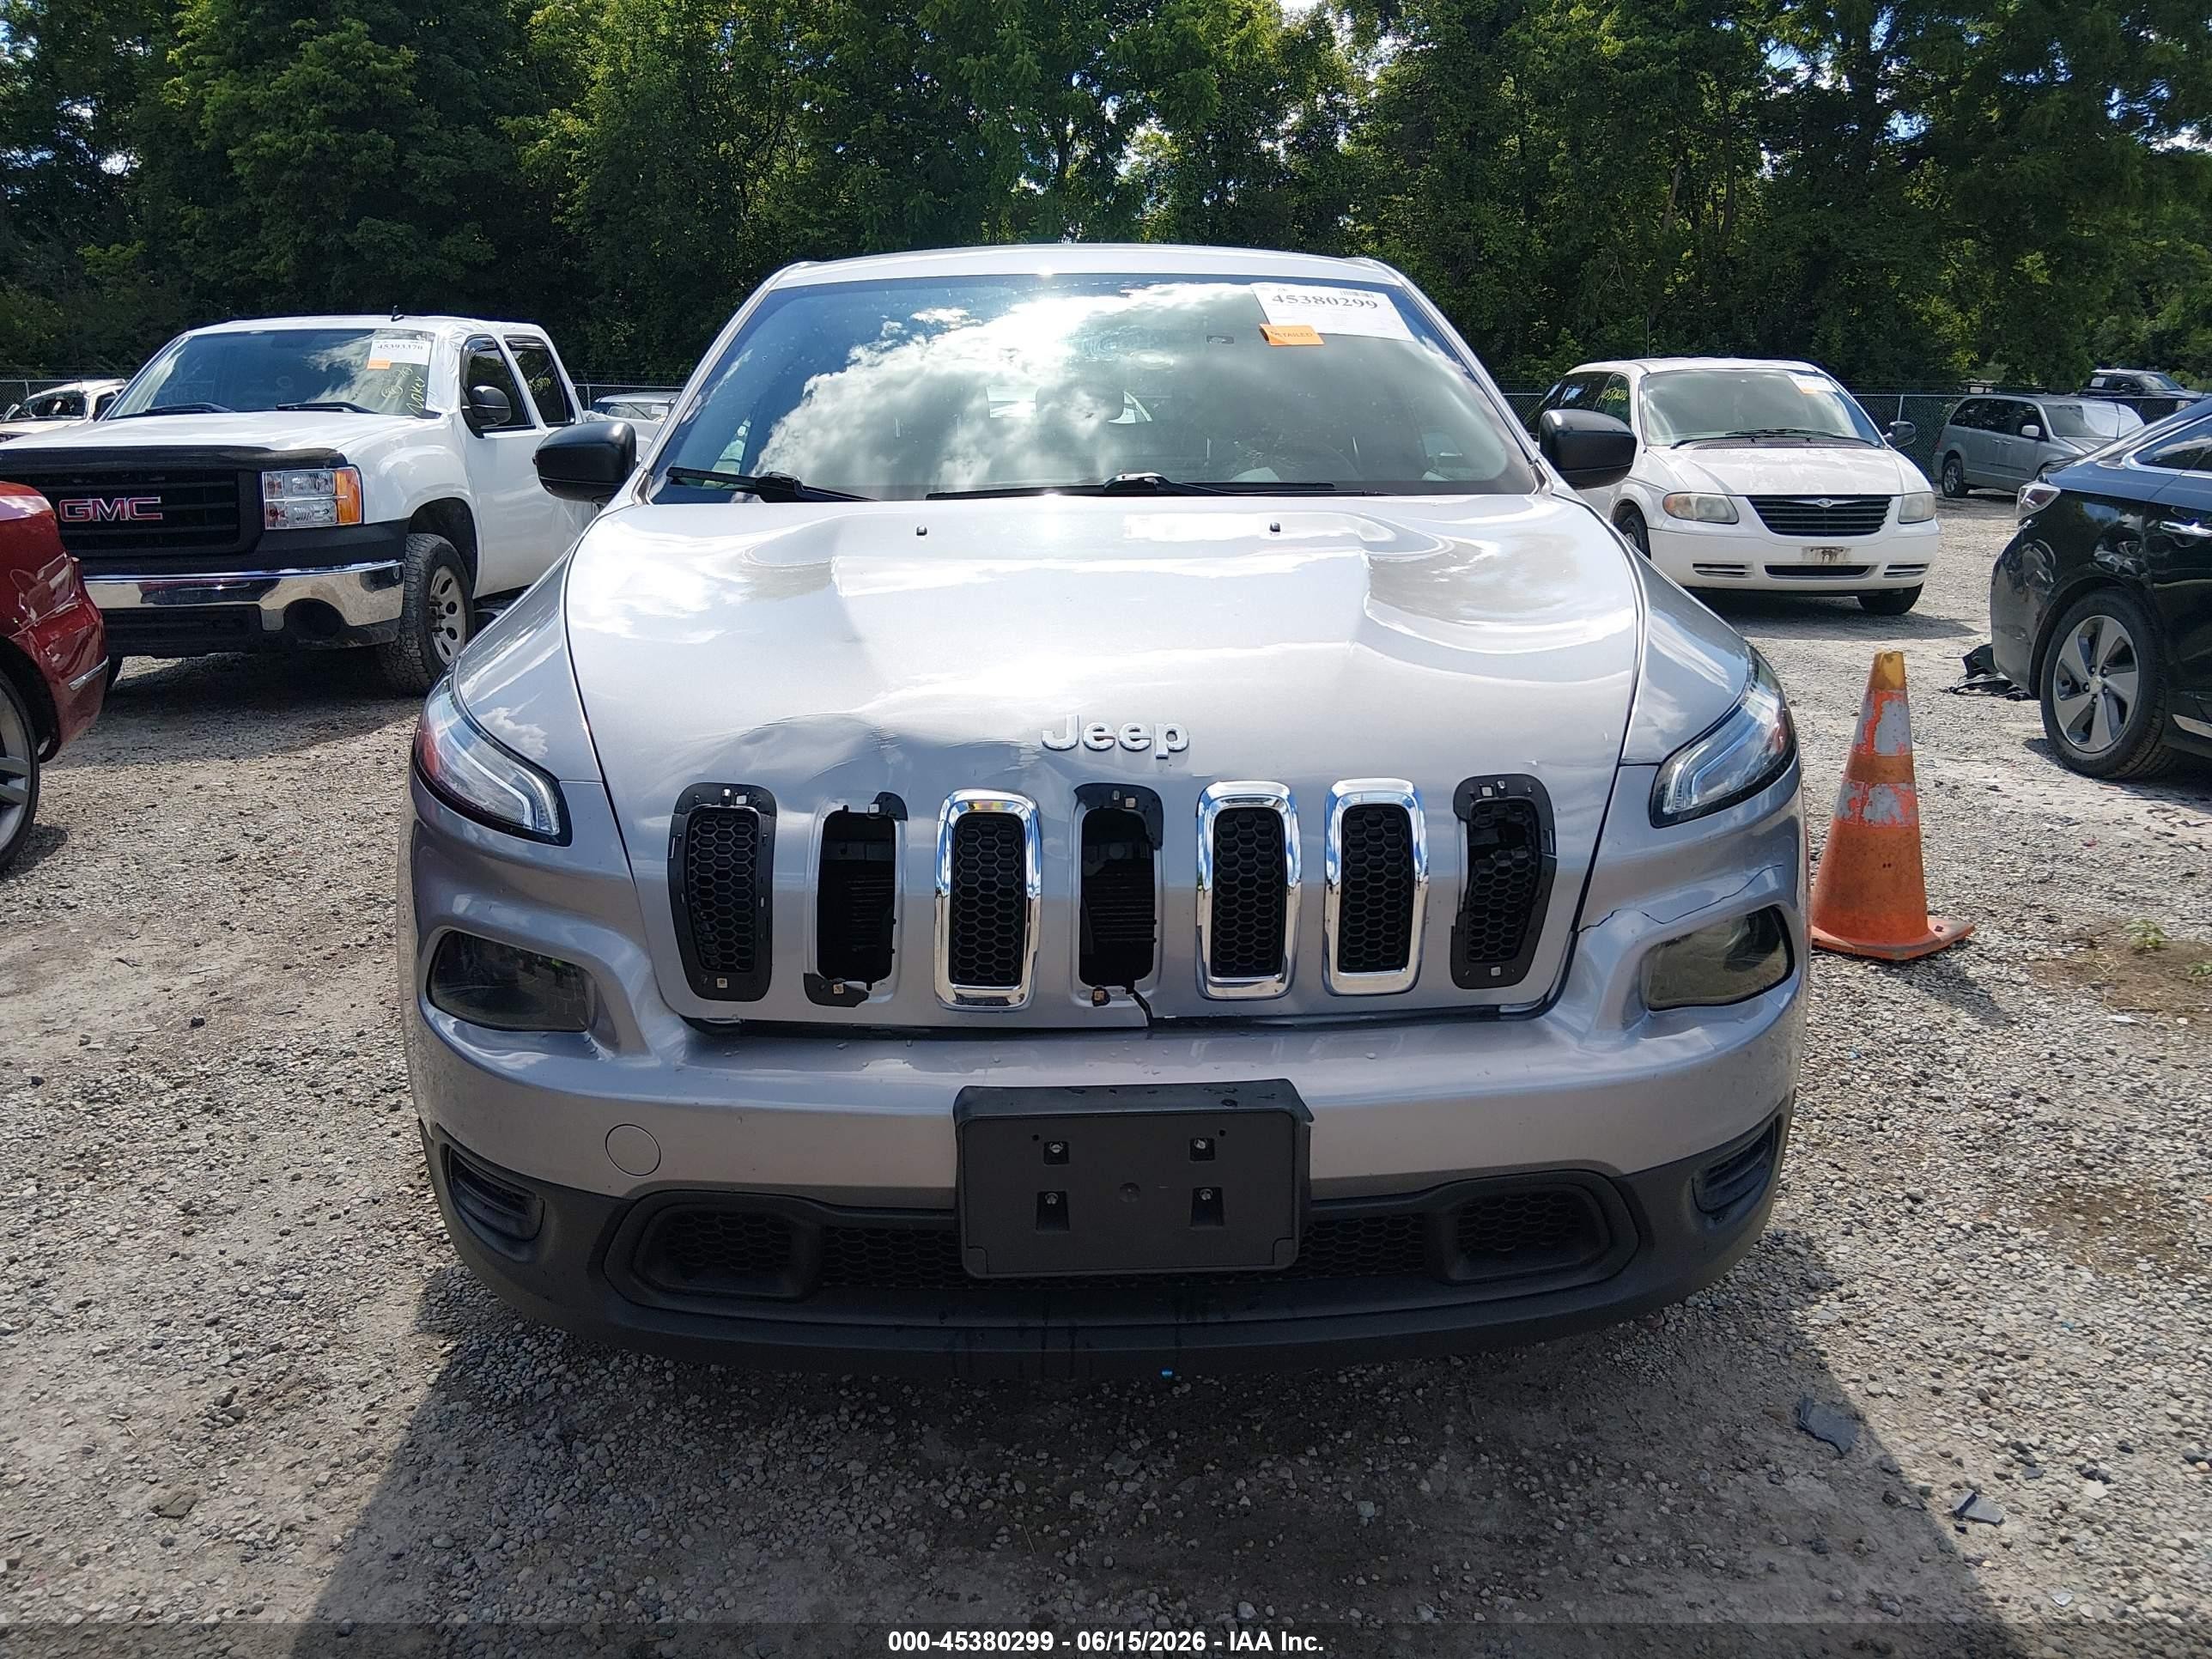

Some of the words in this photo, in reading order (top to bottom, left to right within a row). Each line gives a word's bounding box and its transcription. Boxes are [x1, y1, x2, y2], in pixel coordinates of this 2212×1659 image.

[1272, 294, 1378, 310] 45380299
[59, 496, 163, 522] GMC
[1042, 714, 1189, 759] Jeep
